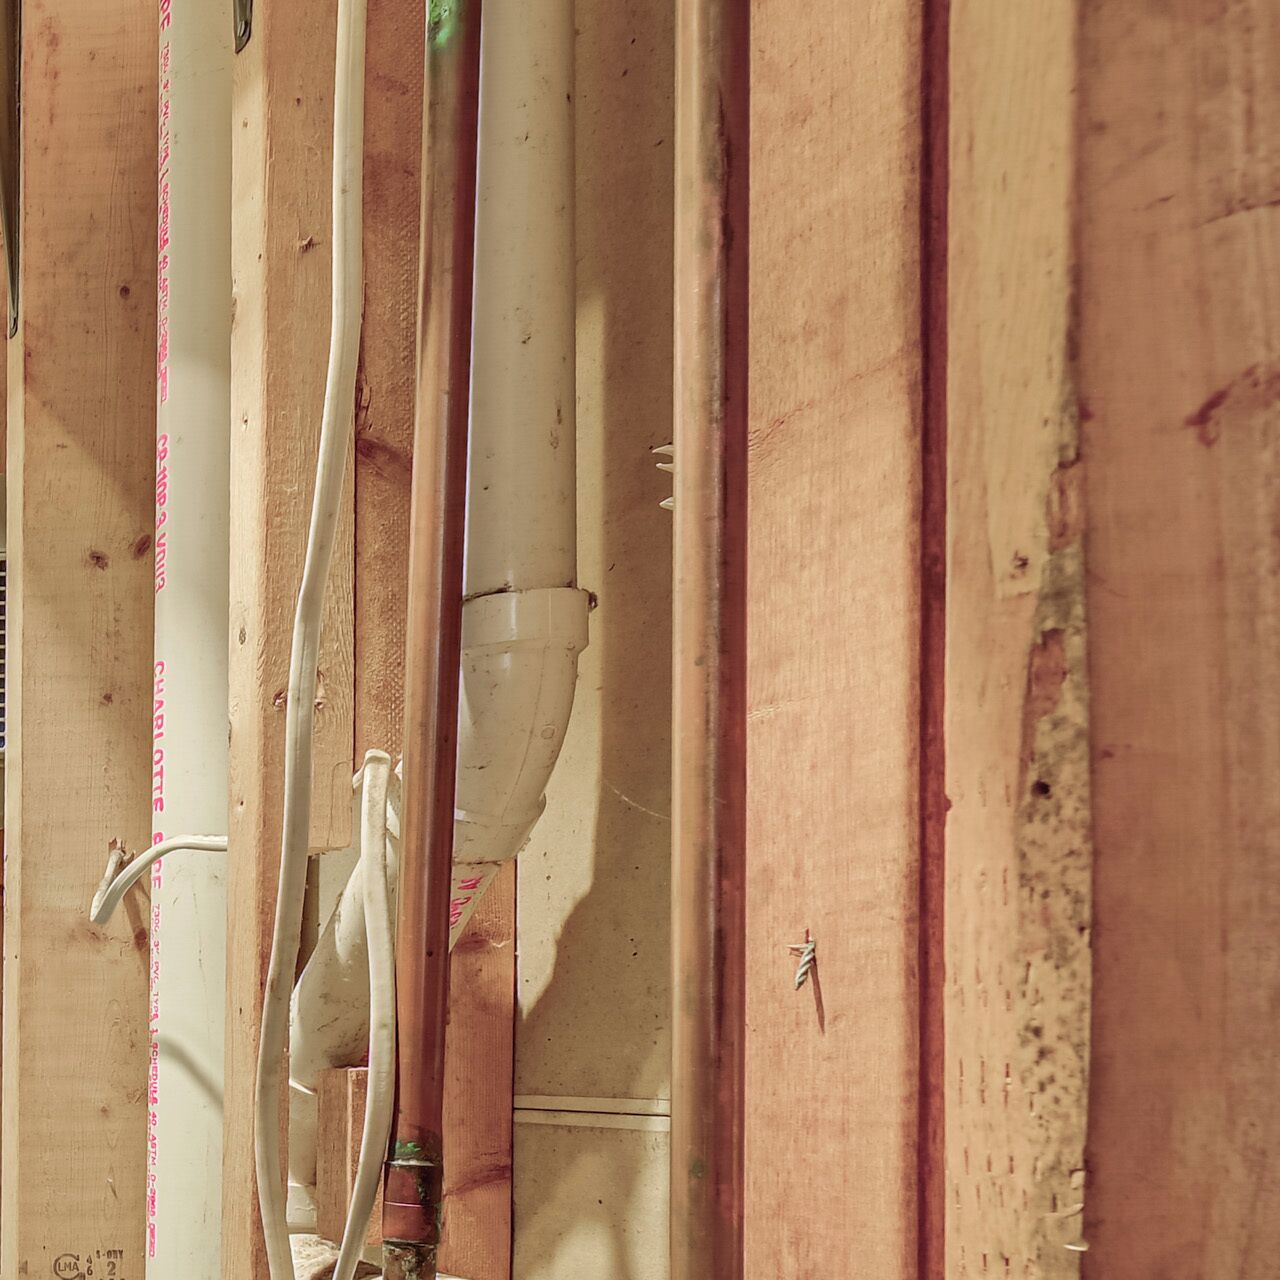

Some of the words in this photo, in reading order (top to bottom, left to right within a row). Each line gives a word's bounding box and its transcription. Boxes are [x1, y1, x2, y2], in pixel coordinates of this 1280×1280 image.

[150, 1042, 159, 1105] SCHEDULE
[149, 1135, 157, 1166] ASTM
[87, 1266, 93, 1276] 6
[107, 1261, 116, 1276] 2
